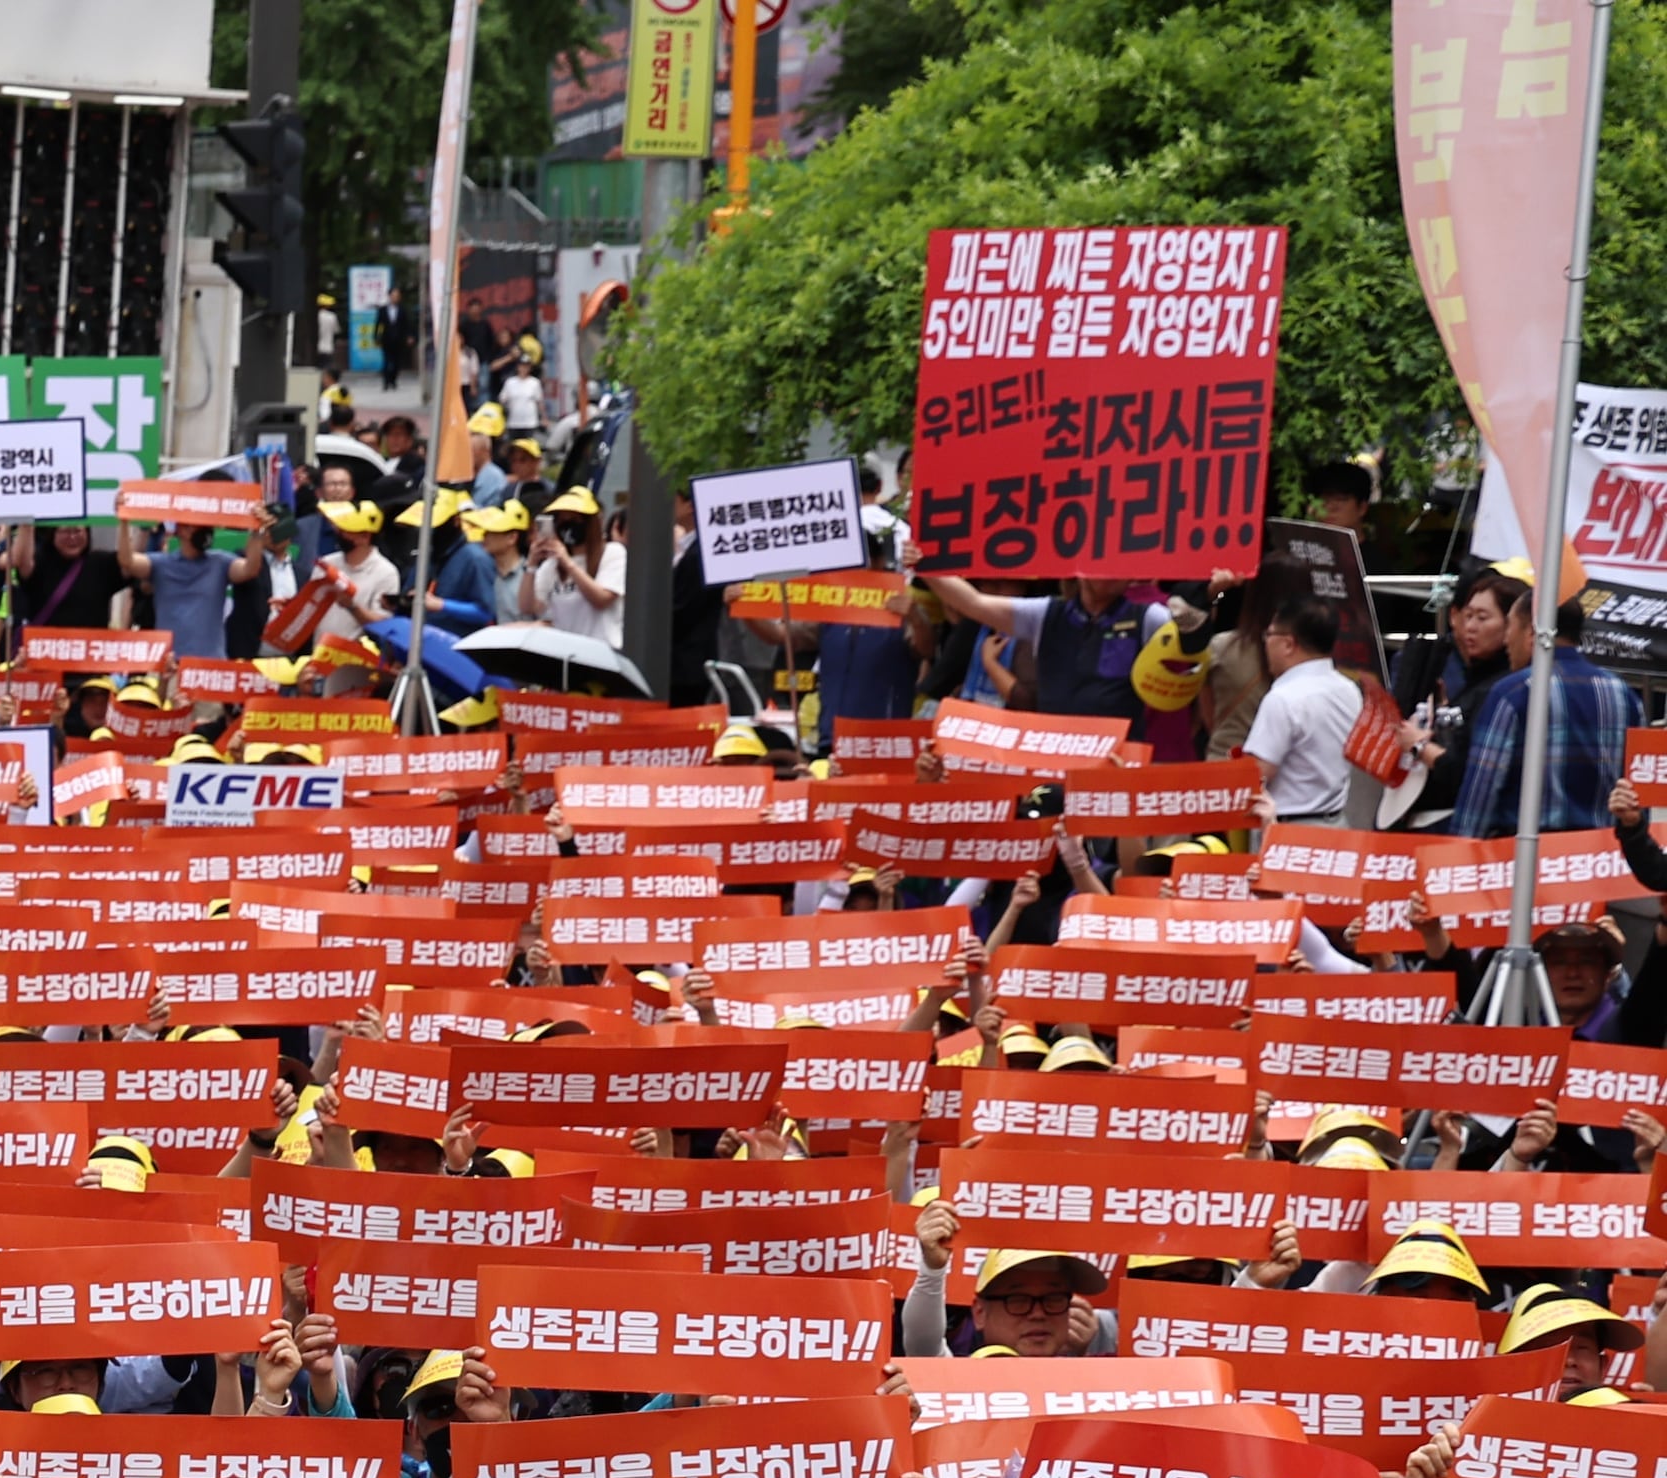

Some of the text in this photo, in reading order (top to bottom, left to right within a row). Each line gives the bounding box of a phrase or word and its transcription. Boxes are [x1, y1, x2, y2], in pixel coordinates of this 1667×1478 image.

[943, 231, 1041, 295] 피곤에
[1045, 231, 1115, 294] 찌든
[923, 298, 1042, 361] 5인미만
[1047, 296, 1114, 359] 힘든
[921, 370, 1047, 449] 우리도!!
[1044, 379, 1264, 462] 최저시급
[707, 486, 846, 529] 세종특별자치시
[919, 452, 1260, 573] 보장하라!!!
[710, 518, 850, 560] 소상공인연합회
[27, 640, 167, 663] 최저임금 구분적용!!
[937, 715, 1117, 758] 생존권을 보장하라!!
[327, 749, 500, 778] 생존권을 보장하라!!
[173, 772, 340, 809] KFME
[702, 934, 952, 972] 생존권을 보장하라!!
[16, 970, 151, 1003] 보장하라!!
[995, 967, 1248, 1007] 생존권을 보장하라!!
[462, 1071, 772, 1103] 생존권을 보장하라!!
[948, 1181, 1275, 1228] 생존권을 보장하라!!
